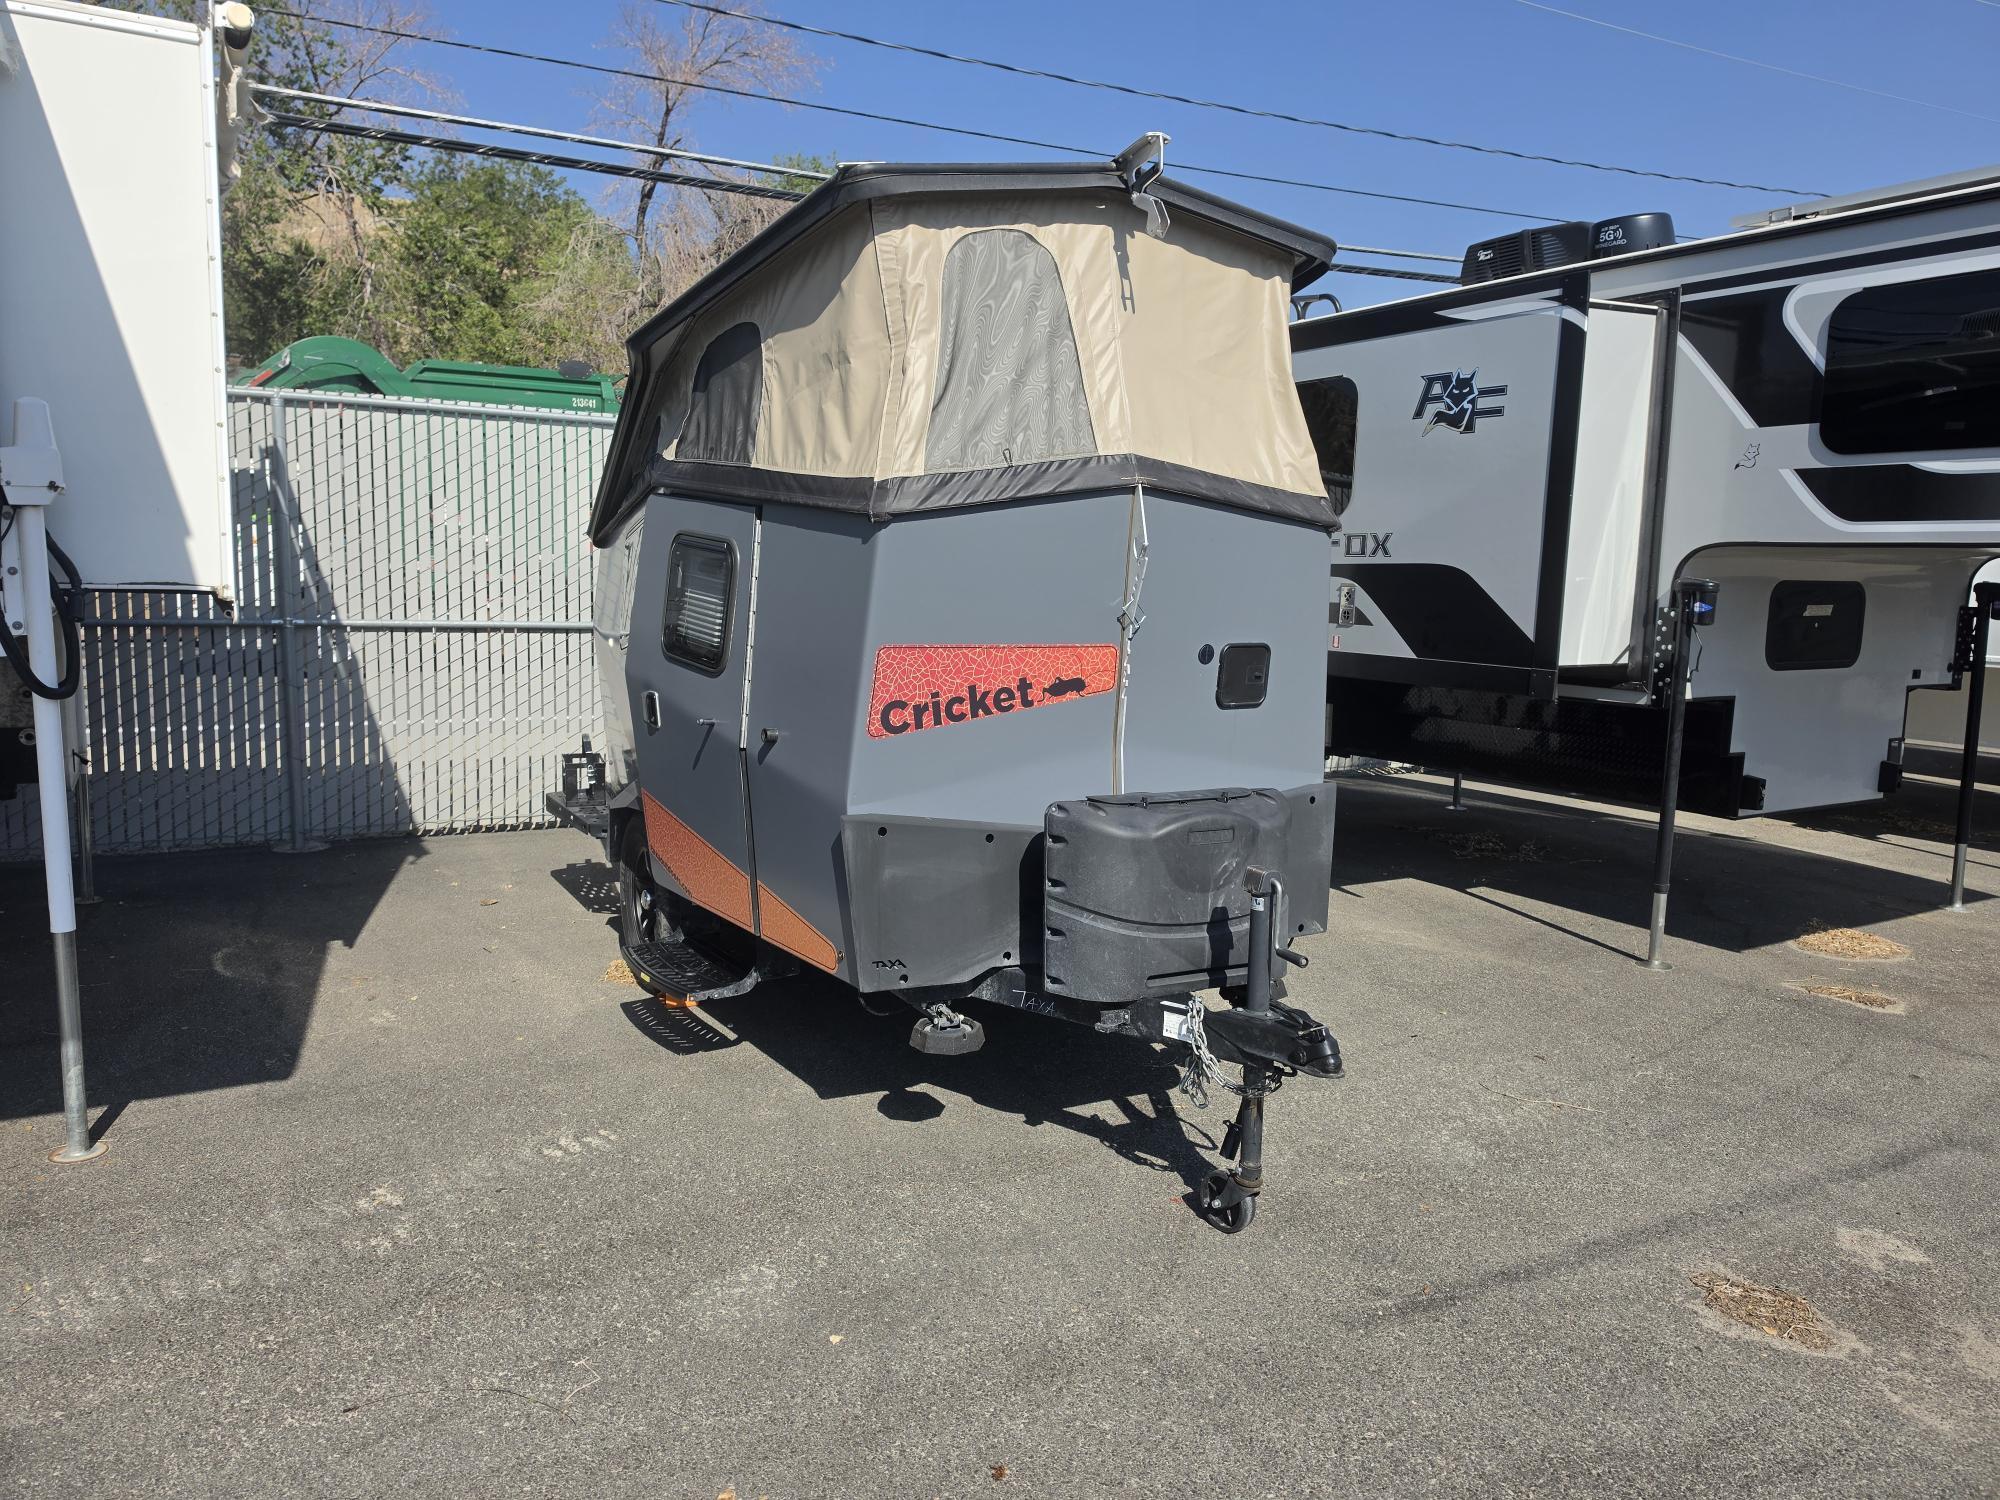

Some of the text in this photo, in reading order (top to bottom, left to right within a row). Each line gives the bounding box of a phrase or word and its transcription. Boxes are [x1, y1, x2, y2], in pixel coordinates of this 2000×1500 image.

[1600, 230, 1614, 242] 5G
[1331, 532, 1393, 558] OX
[880, 676, 1035, 735] Cricket
[871, 959, 907, 970] TAXA
